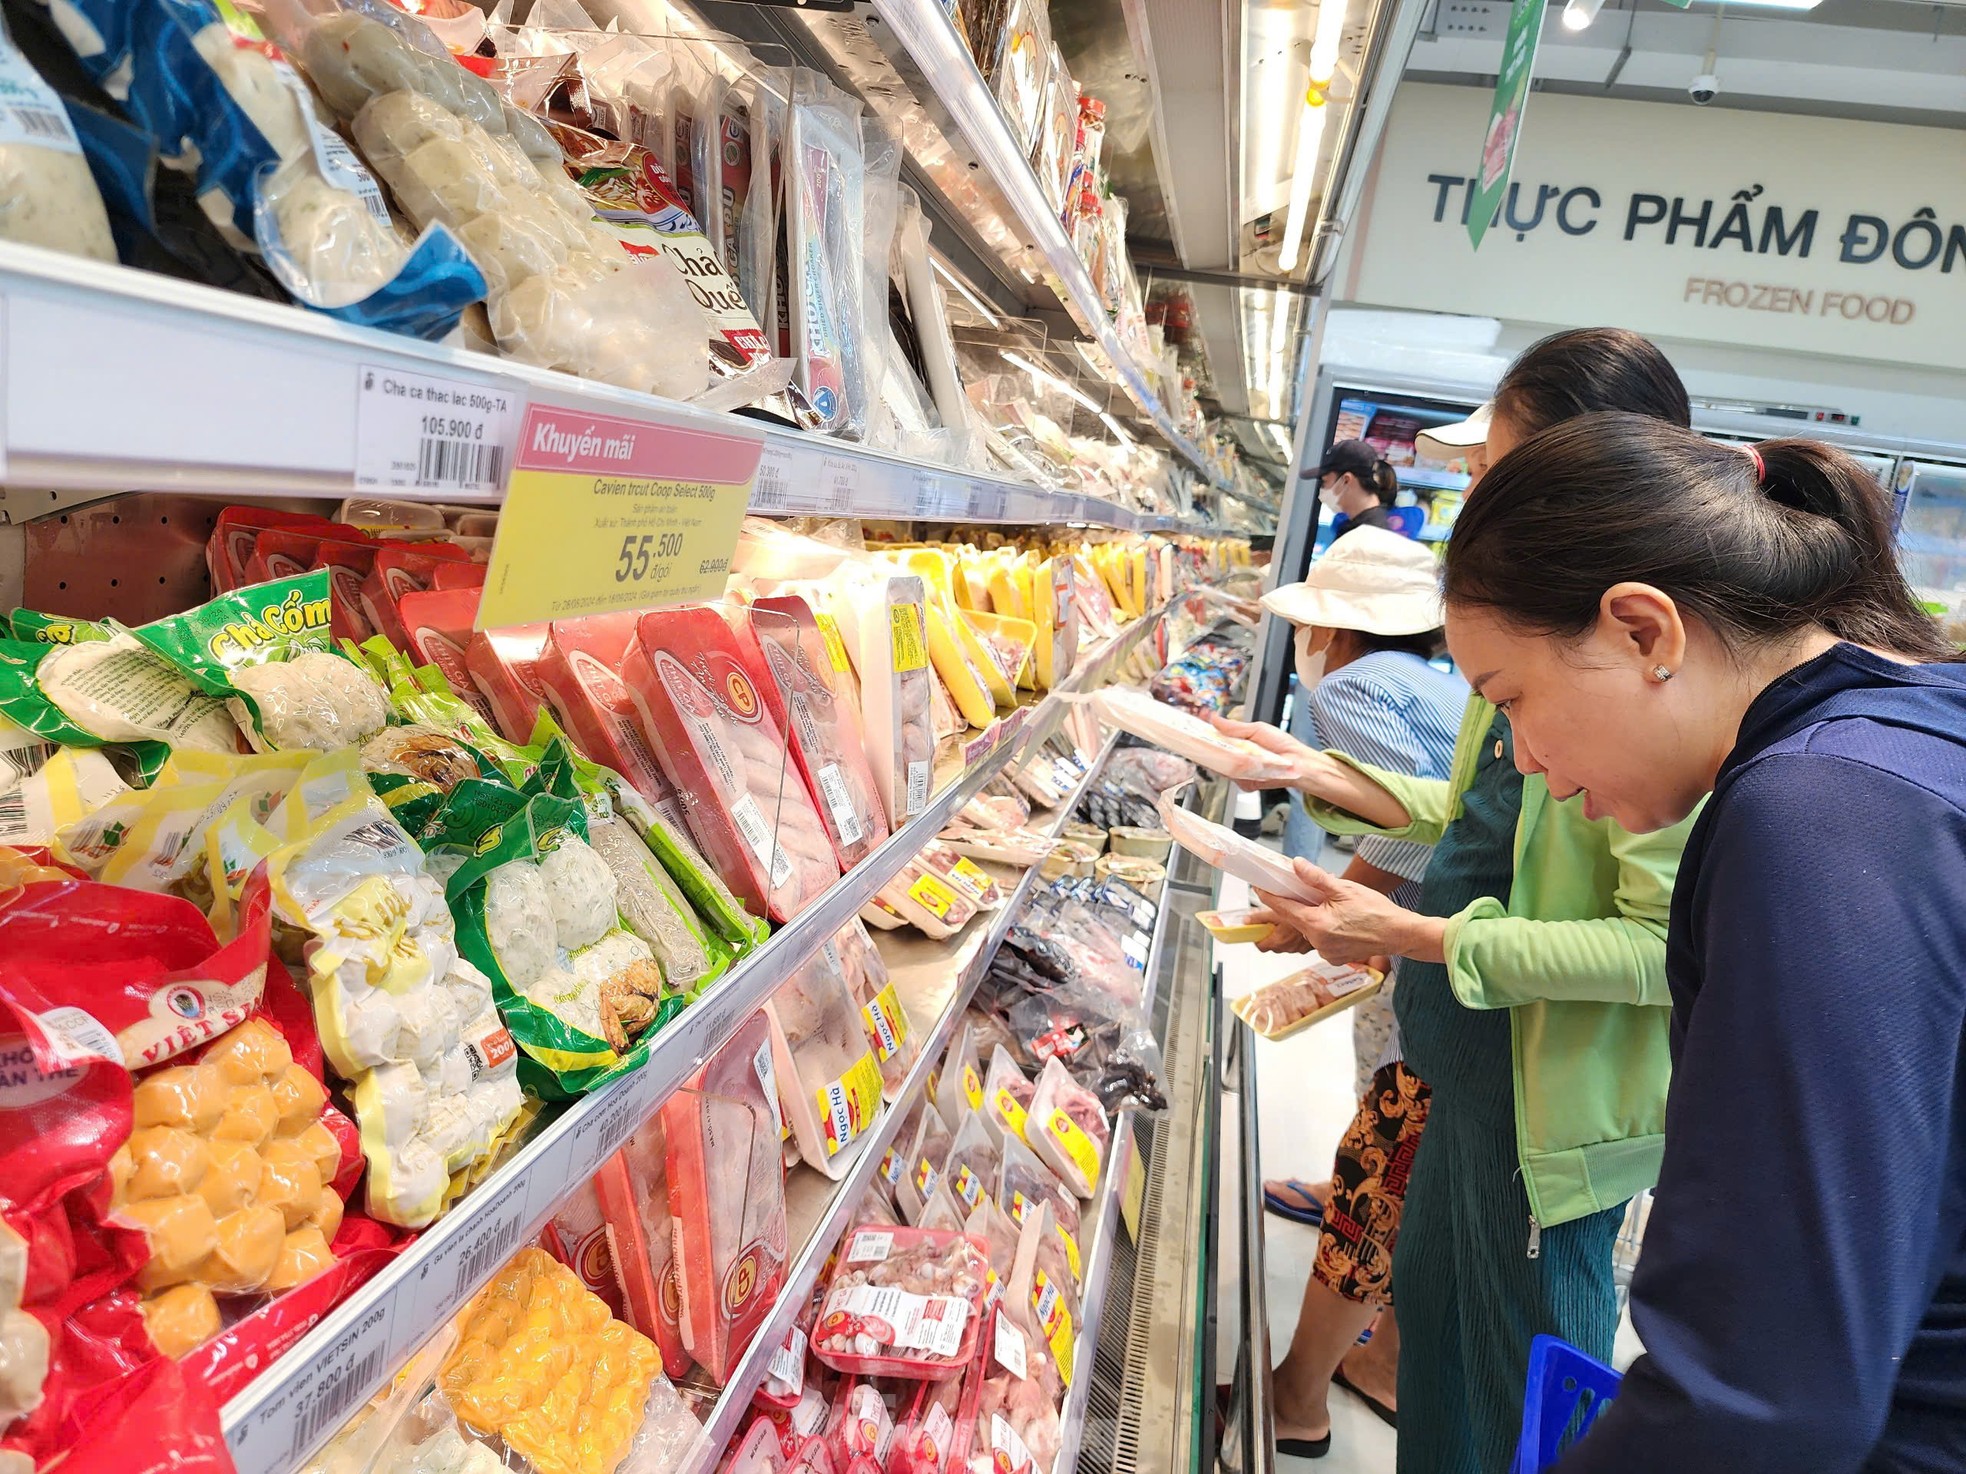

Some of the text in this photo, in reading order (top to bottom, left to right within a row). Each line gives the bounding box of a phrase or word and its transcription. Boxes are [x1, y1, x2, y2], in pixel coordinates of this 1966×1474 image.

[1623, 184, 1818, 258] PHẨM
[662, 243, 723, 277] Chả
[1684, 277, 1916, 325] FROZEN FOOD
[383, 379, 507, 413] Cha ca thac lac 500g-TA
[422, 415, 484, 440] 105.900 đ
[532, 423, 635, 462] Khuyến mãi
[593, 479, 626, 495] Cavien
[651, 482, 673, 500] Coop
[673, 483, 697, 498] Select
[698, 485, 715, 502] 500g
[615, 536, 653, 582] 55
[262, 590, 331, 635] Cốm
[732, 678, 750, 707] CP
[880, 1022, 894, 1051] Ngọc
[830, 1087, 848, 1143] Ngọc Hà
[458, 1225, 493, 1267] 26.400
[739, 1268, 750, 1297] CP
[260, 1397, 286, 1425] Tom
[289, 1372, 313, 1398] vien
[317, 1329, 360, 1373] VIETSIN
[362, 1307, 385, 1335] 200g
[294, 1366, 342, 1418] 37.800
